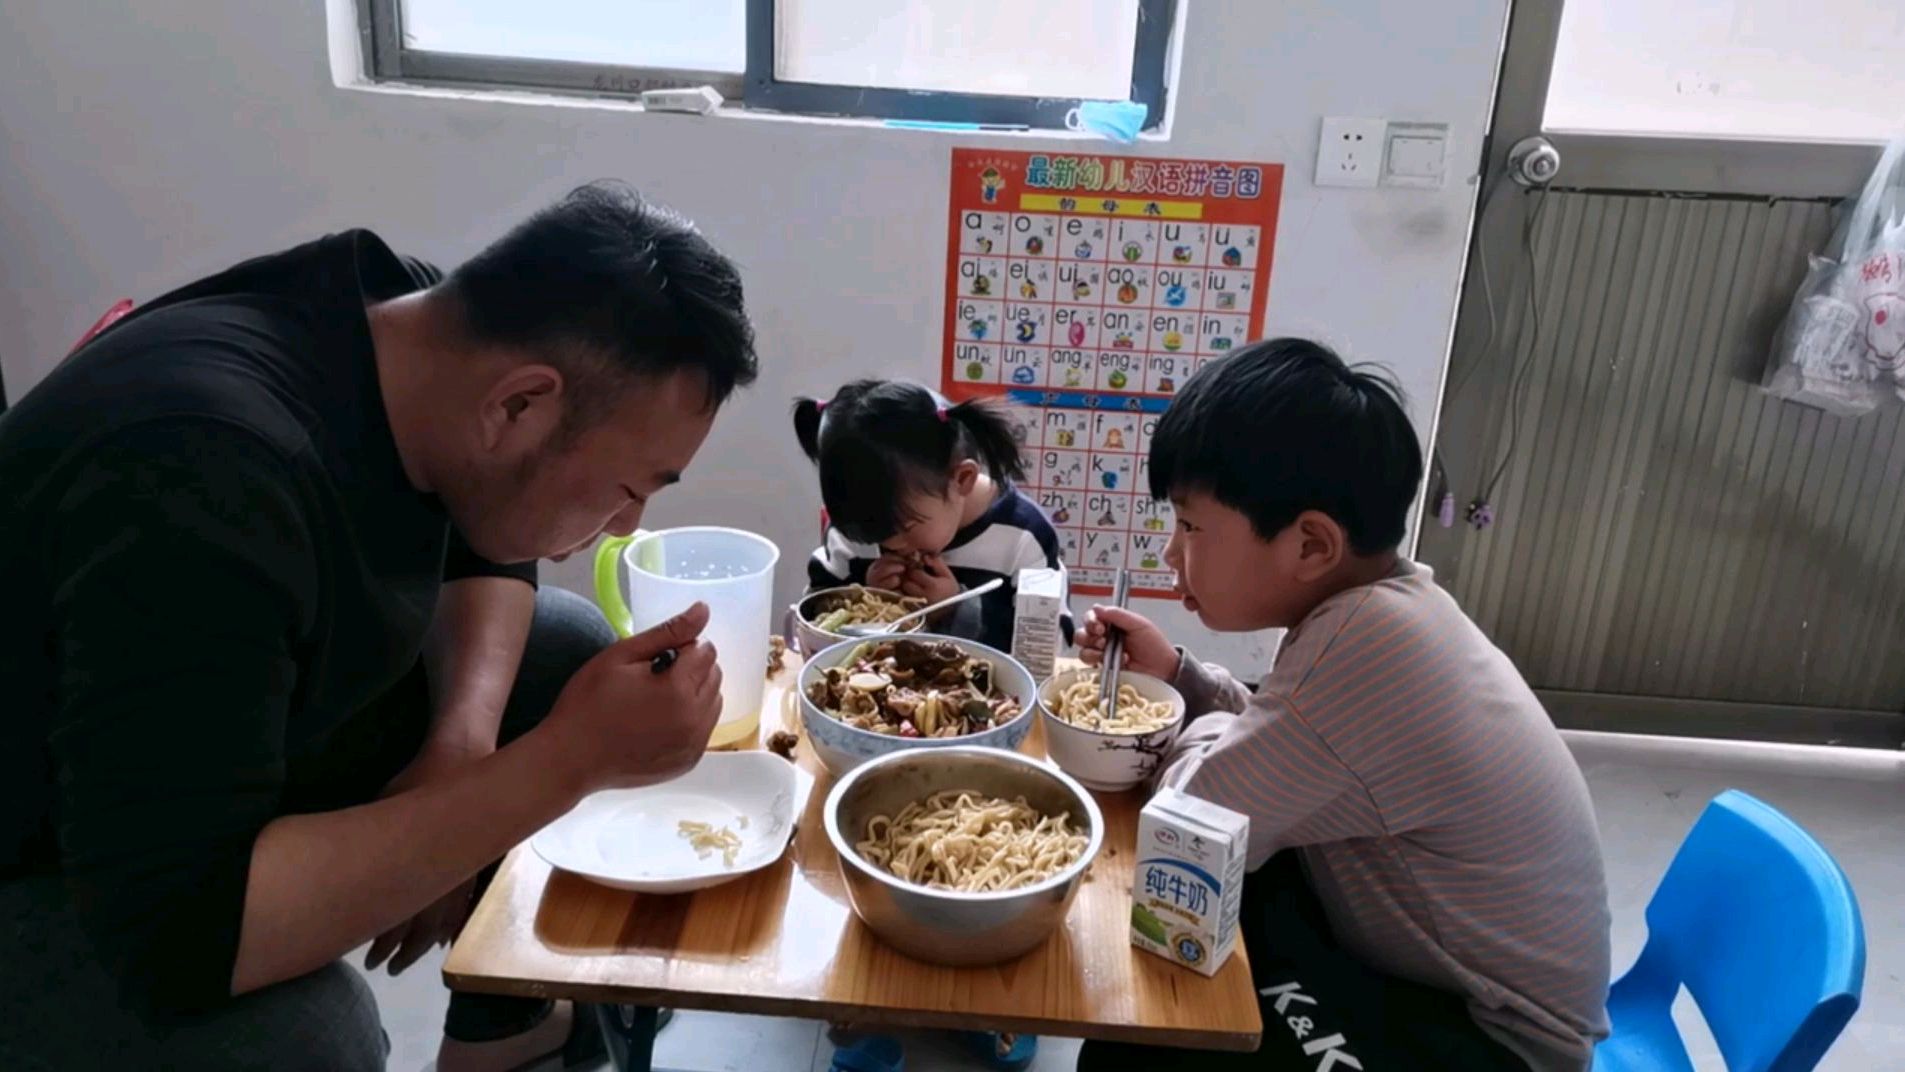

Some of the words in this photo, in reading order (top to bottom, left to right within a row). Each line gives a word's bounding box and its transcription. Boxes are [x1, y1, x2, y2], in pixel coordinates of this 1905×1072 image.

[1025, 154, 1263, 199] 最新幼儿汉语拼音图
[965, 212, 982, 229] a
[1015, 216, 1031, 232] o
[1067, 219, 1082, 235] e
[1118, 221, 1124, 241] i
[1165, 224, 1181, 241] u
[1107, 268, 1134, 284] ao
[1158, 271, 1182, 286] ou
[1208, 271, 1226, 290] iu
[1055, 309, 1077, 324] er
[1103, 312, 1129, 329] an
[1153, 315, 1179, 332] en
[1202, 315, 1221, 334] in
[956, 344, 979, 360] un
[1051, 350, 1082, 368] ang
[1100, 353, 1131, 371] eng
[1047, 412, 1066, 426] m
[1096, 414, 1104, 433] f
[1044, 452, 1058, 468] g
[1093, 454, 1103, 471] k
[1041, 491, 1064, 507] zh
[1088, 494, 1112, 511] ch
[1086, 533, 1098, 548] y
[1133, 534, 1152, 549] w
[1145, 865, 1209, 917] 纯牛奶
